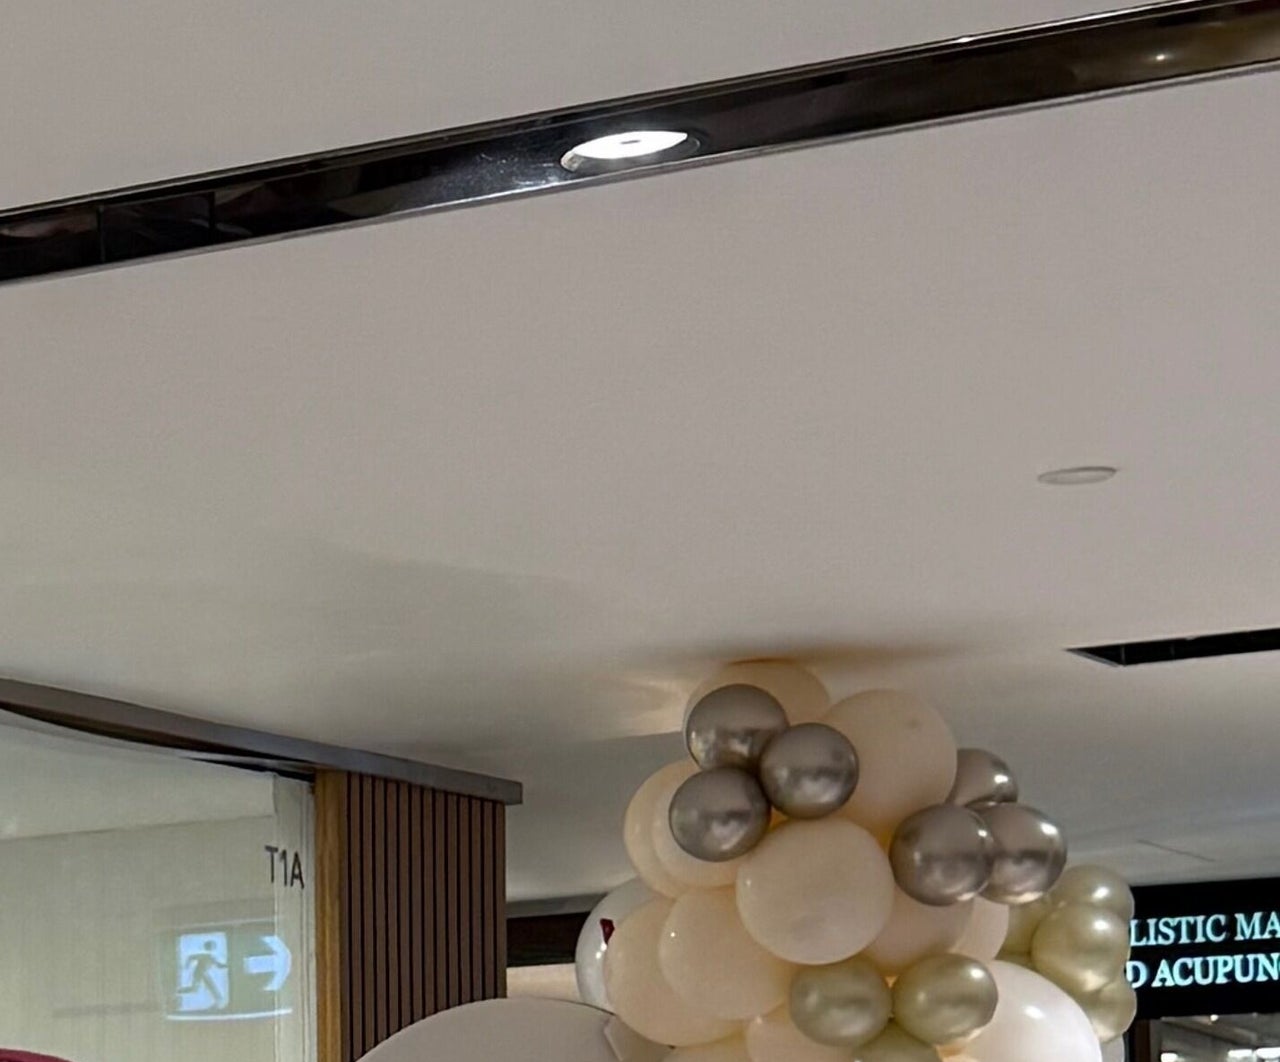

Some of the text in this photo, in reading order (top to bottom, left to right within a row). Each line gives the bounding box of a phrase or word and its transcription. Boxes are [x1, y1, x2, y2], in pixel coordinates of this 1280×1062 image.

[264, 845, 305, 890] T1A
[1129, 913, 1227, 947] LISTIC
[1126, 960, 1149, 989] D
